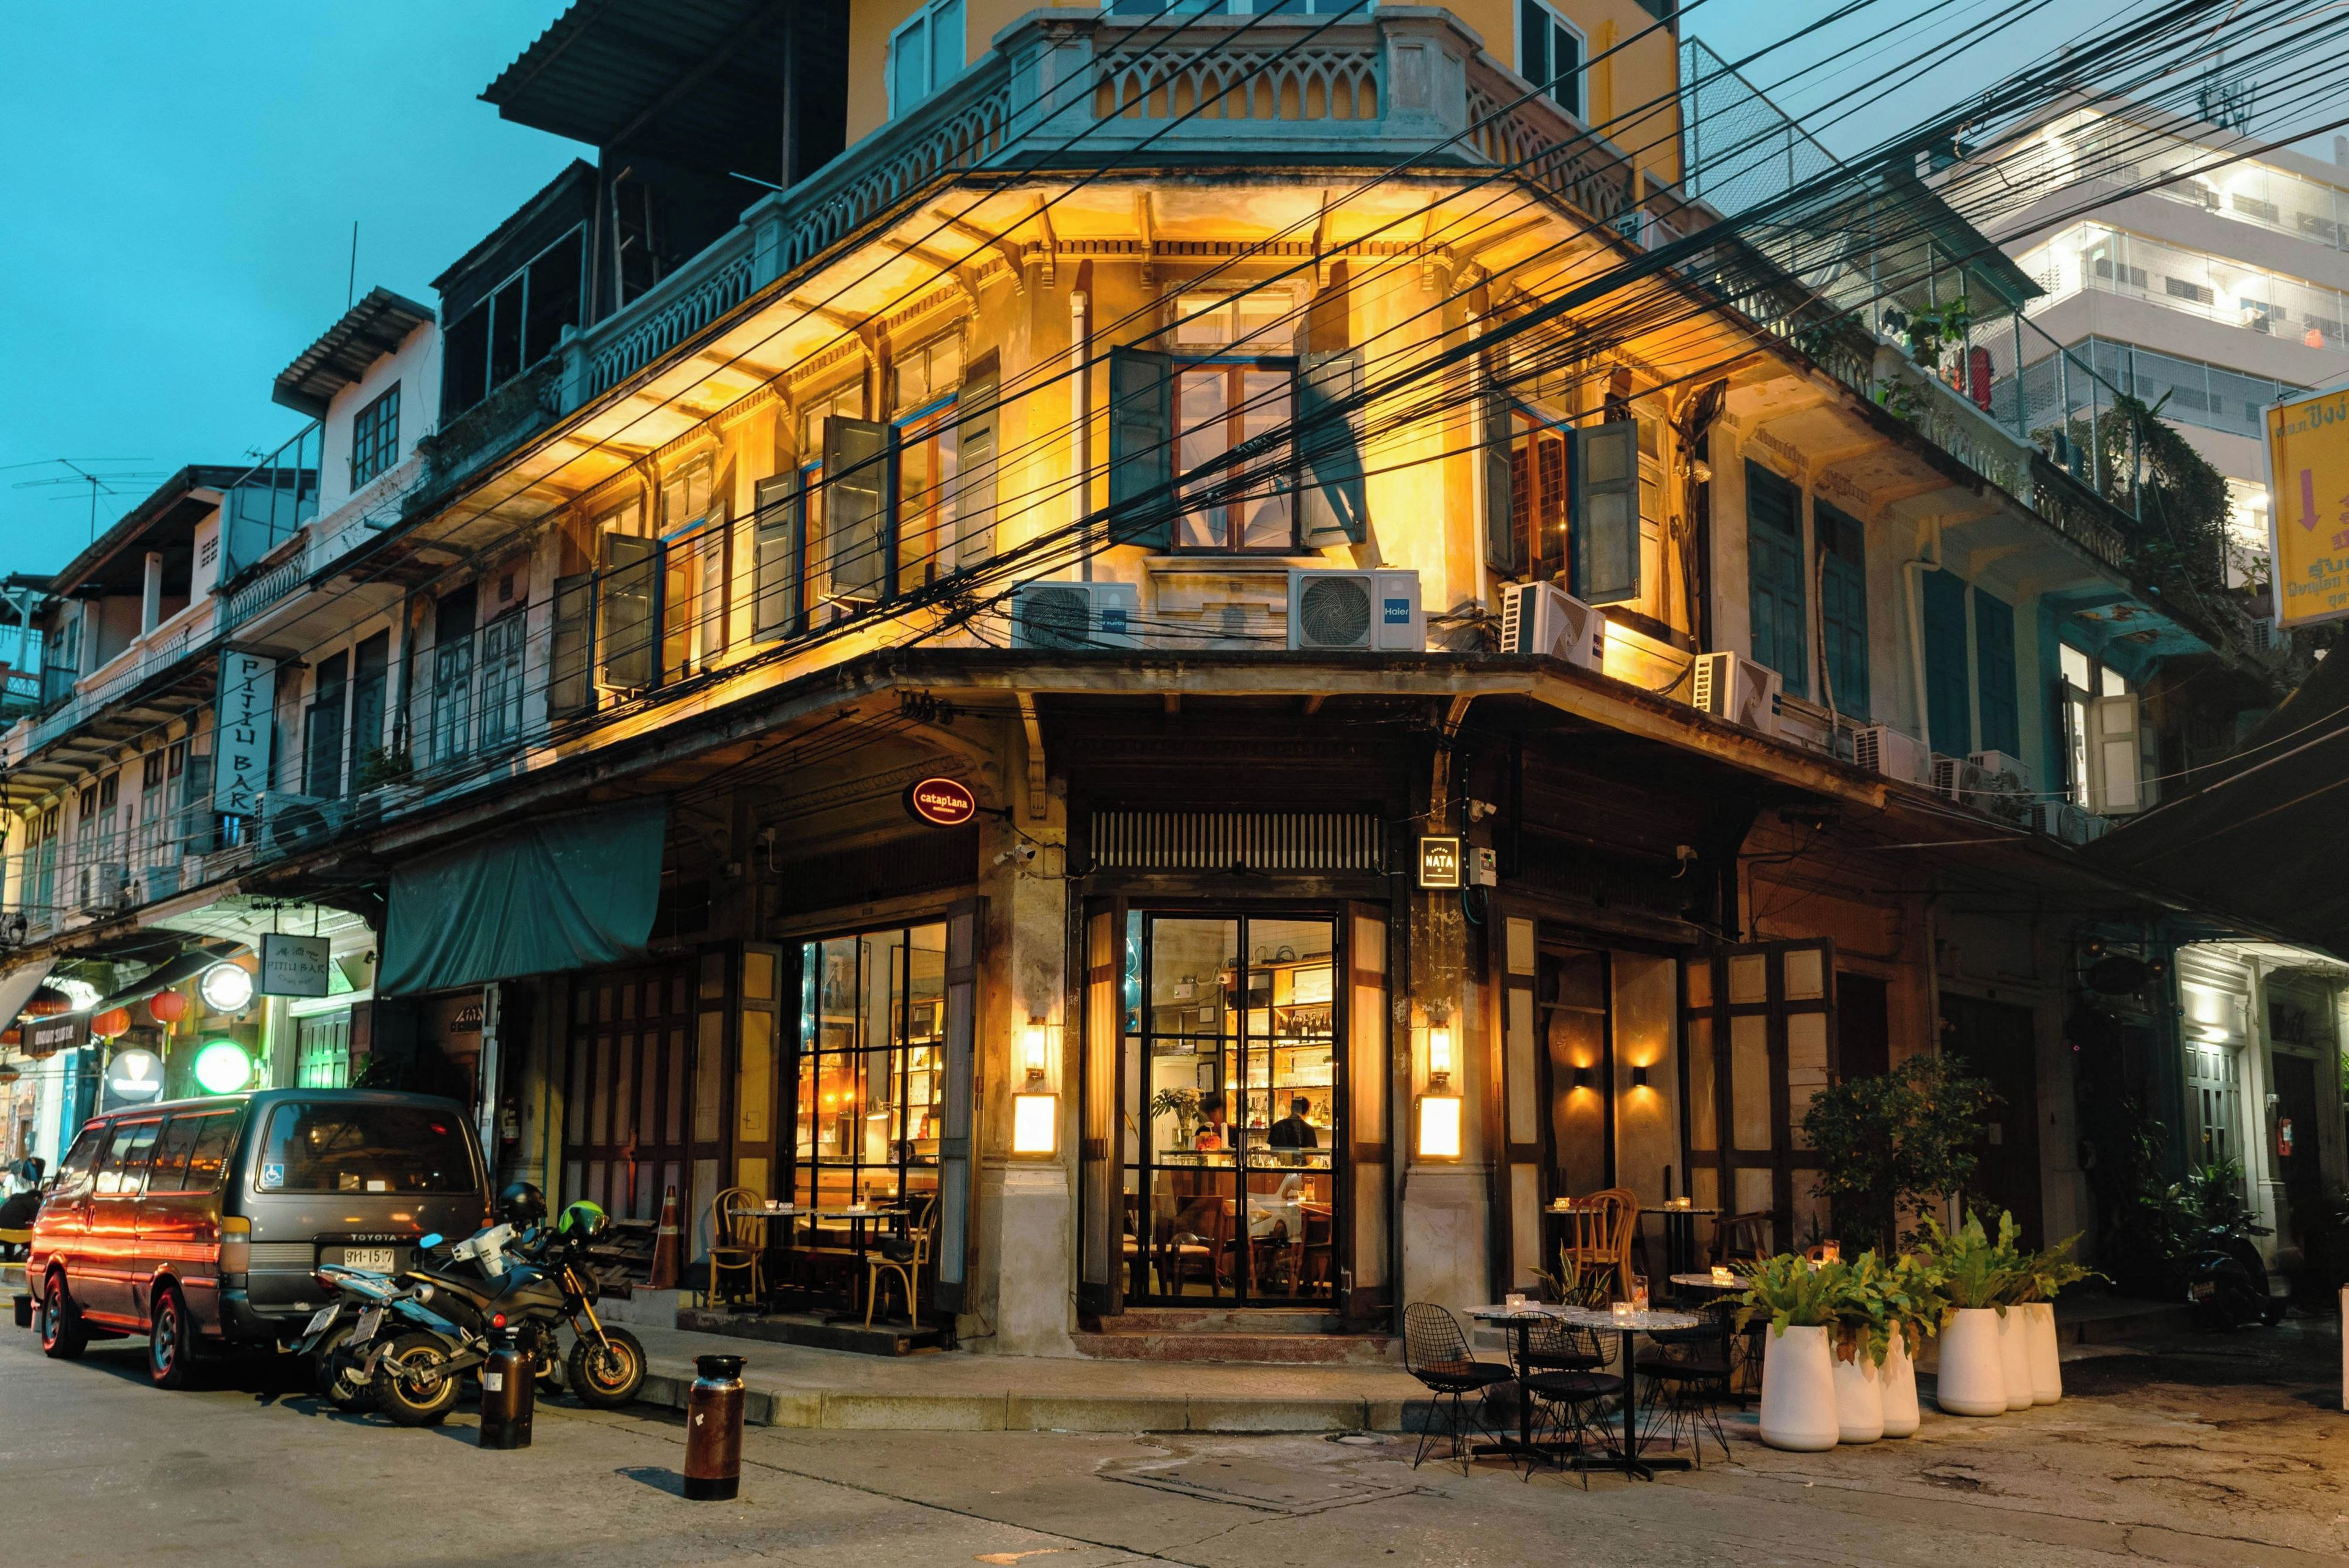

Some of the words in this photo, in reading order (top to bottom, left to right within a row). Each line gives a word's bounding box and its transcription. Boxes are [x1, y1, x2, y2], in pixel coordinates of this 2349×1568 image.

[235, 658, 259, 745] PIJIU
[231, 754, 254, 809] BAR
[920, 794, 968, 809] cataplana
[1426, 855, 1453, 868] NATA
[300, 963, 325, 974] BAR
